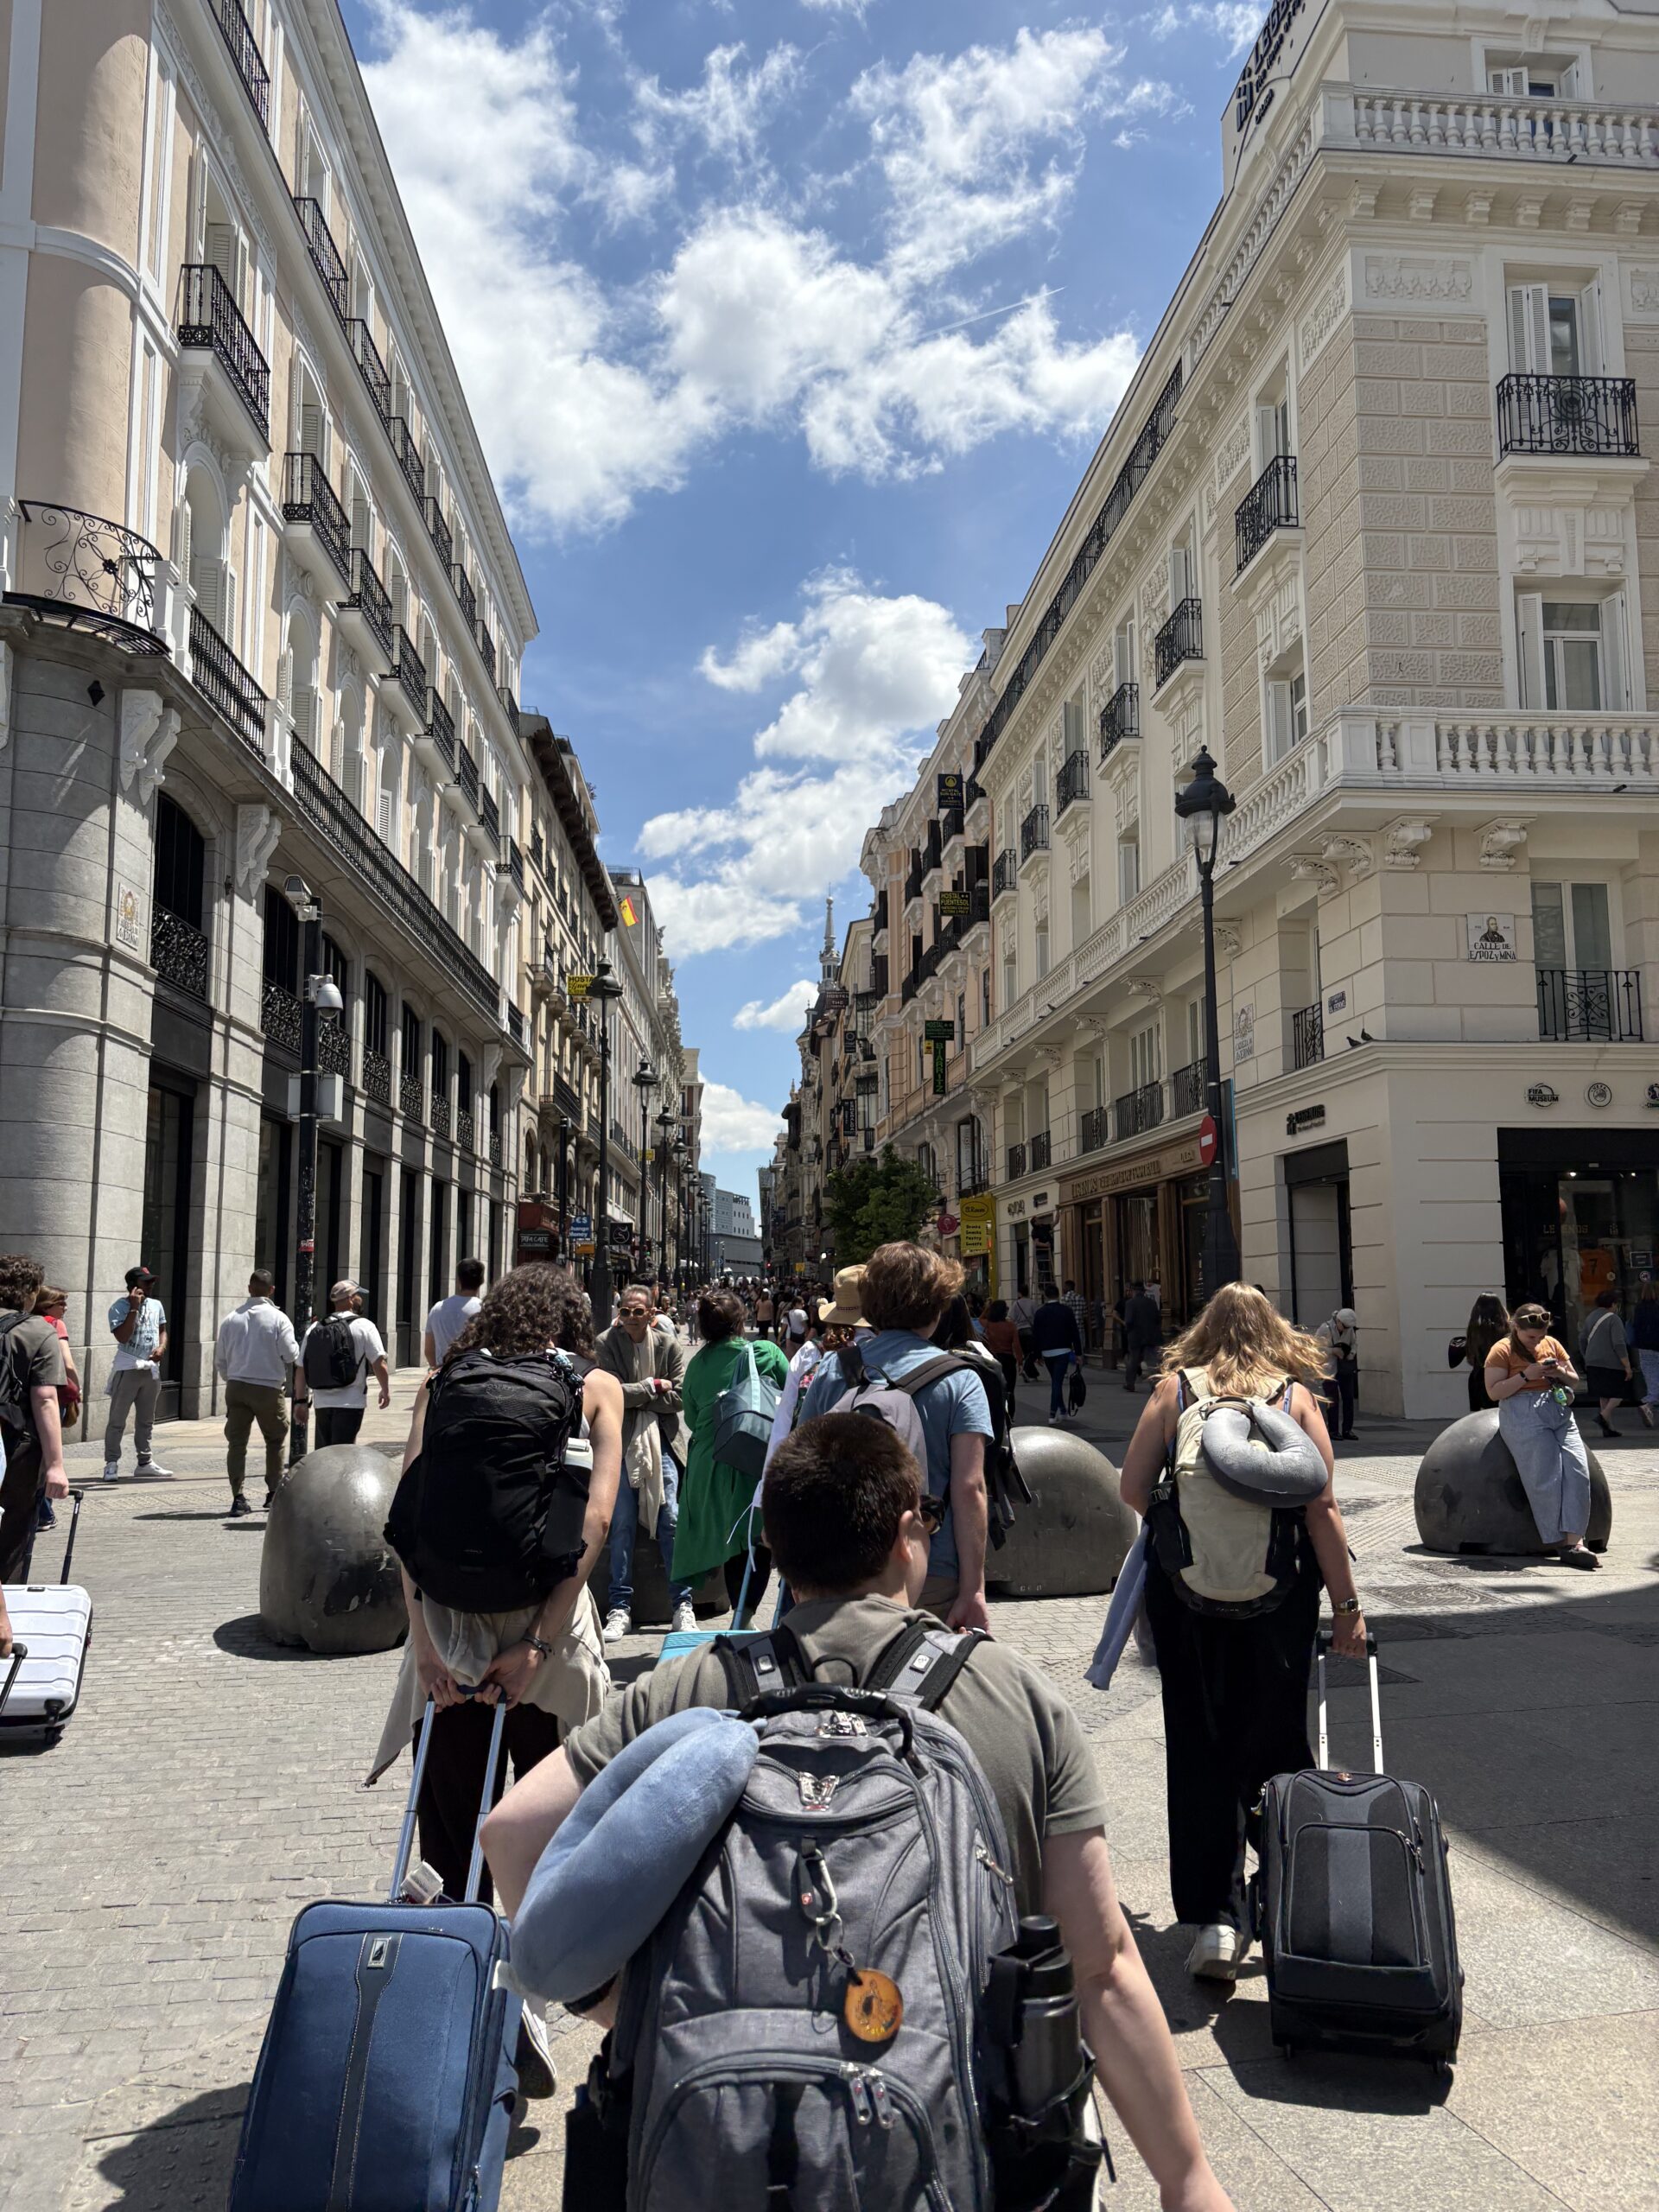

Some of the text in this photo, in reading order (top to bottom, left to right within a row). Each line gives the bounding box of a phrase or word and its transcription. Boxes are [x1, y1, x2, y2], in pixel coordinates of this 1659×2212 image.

[1474, 942, 1500, 950] CALLE
[1470, 950, 1495, 960] ESPOZ
[1499, 950, 1516, 960] MINA
[1543, 1224, 1588, 1234] LEENDS
[1588, 1258, 1598, 1274] 7
